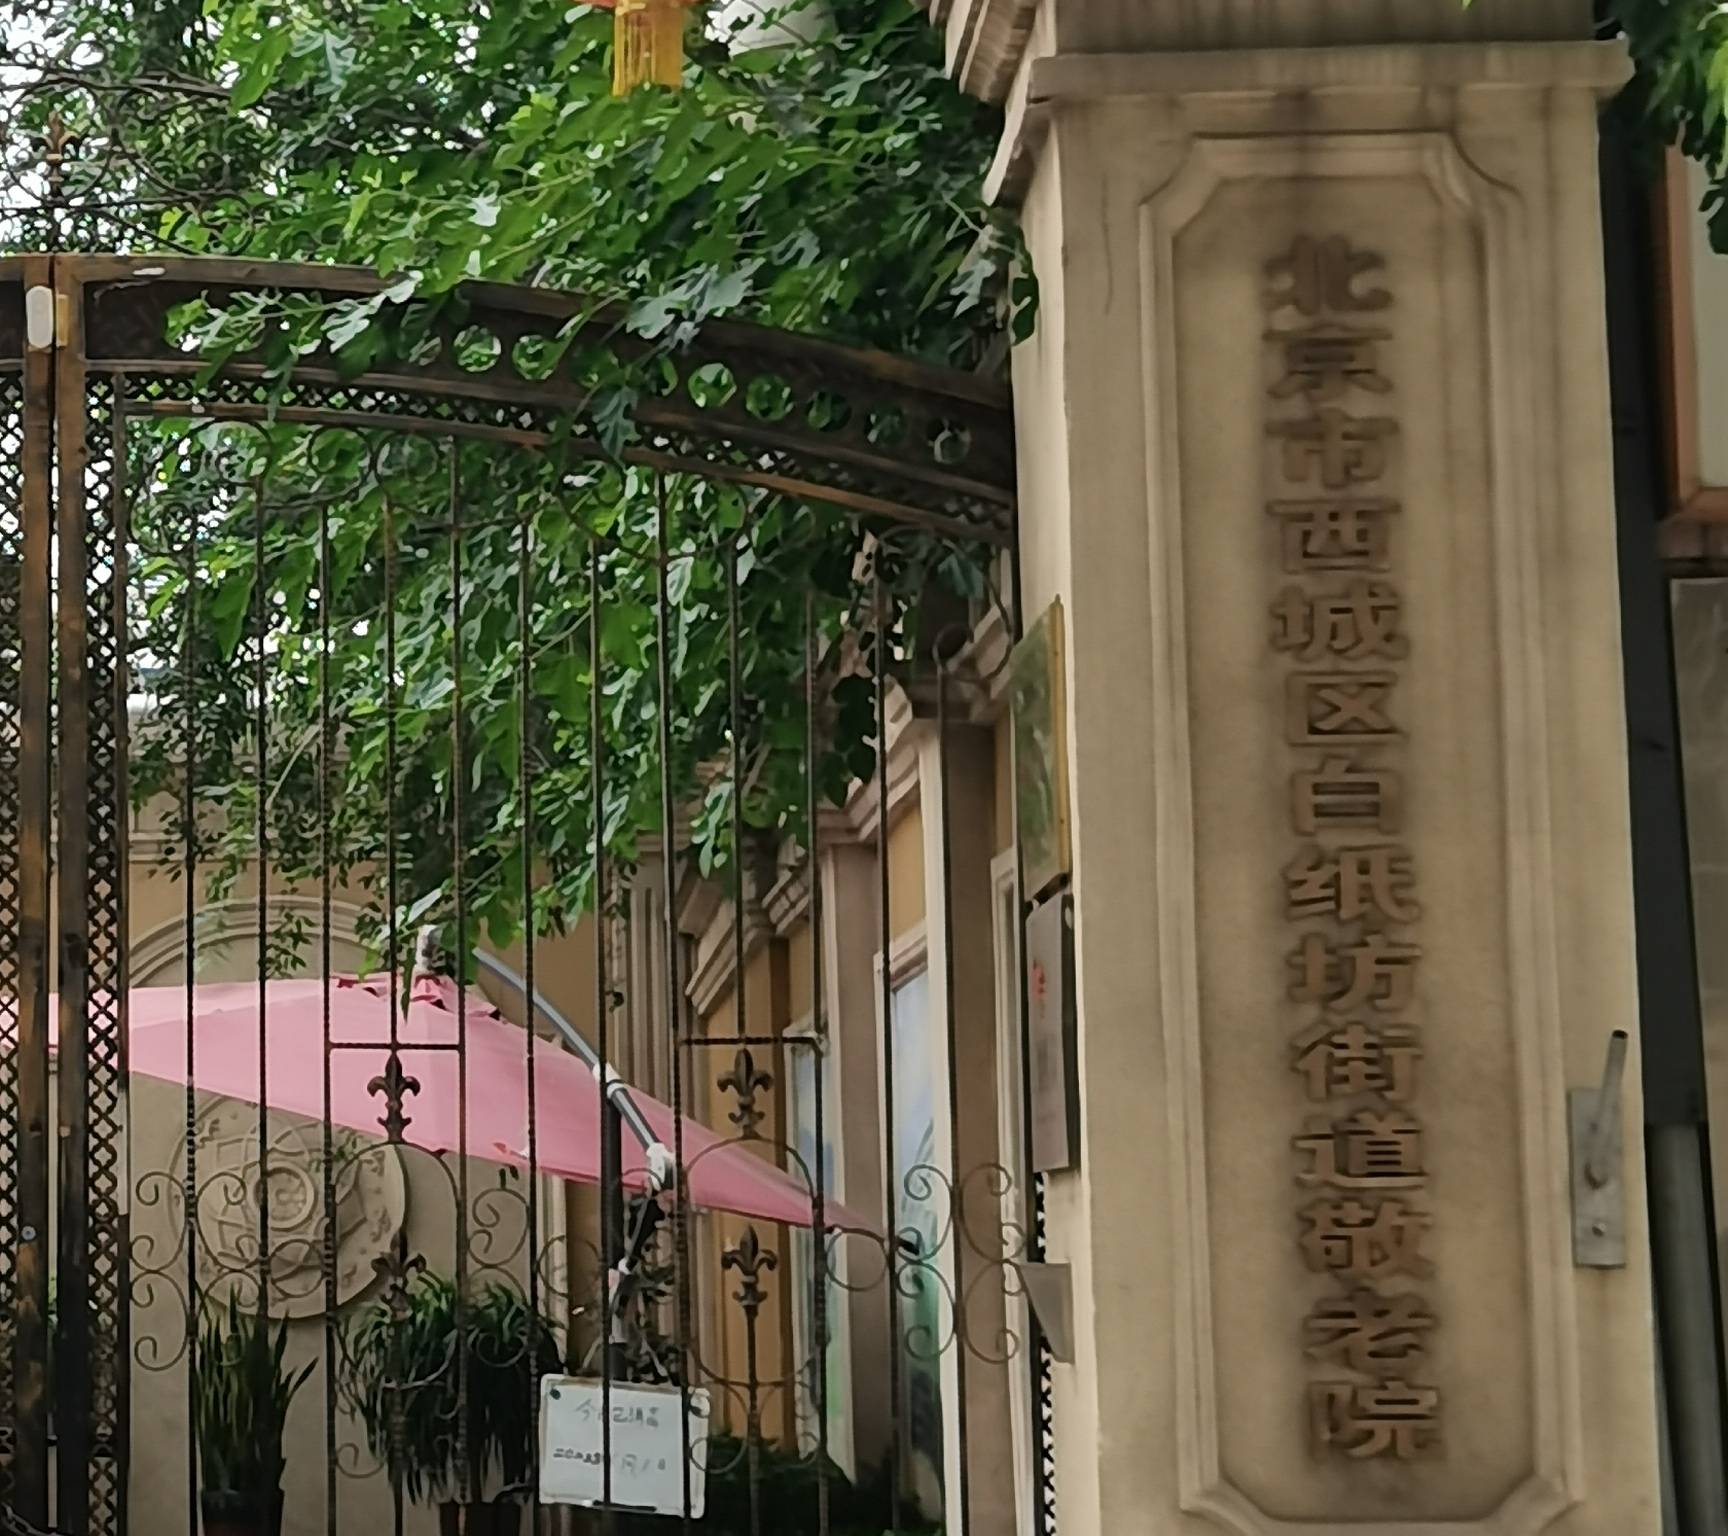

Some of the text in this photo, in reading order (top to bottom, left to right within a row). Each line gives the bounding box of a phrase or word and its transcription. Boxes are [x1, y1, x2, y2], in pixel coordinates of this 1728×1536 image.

[1261, 233, 1441, 1460] 北京市西城区白纸坊街道敬老院
